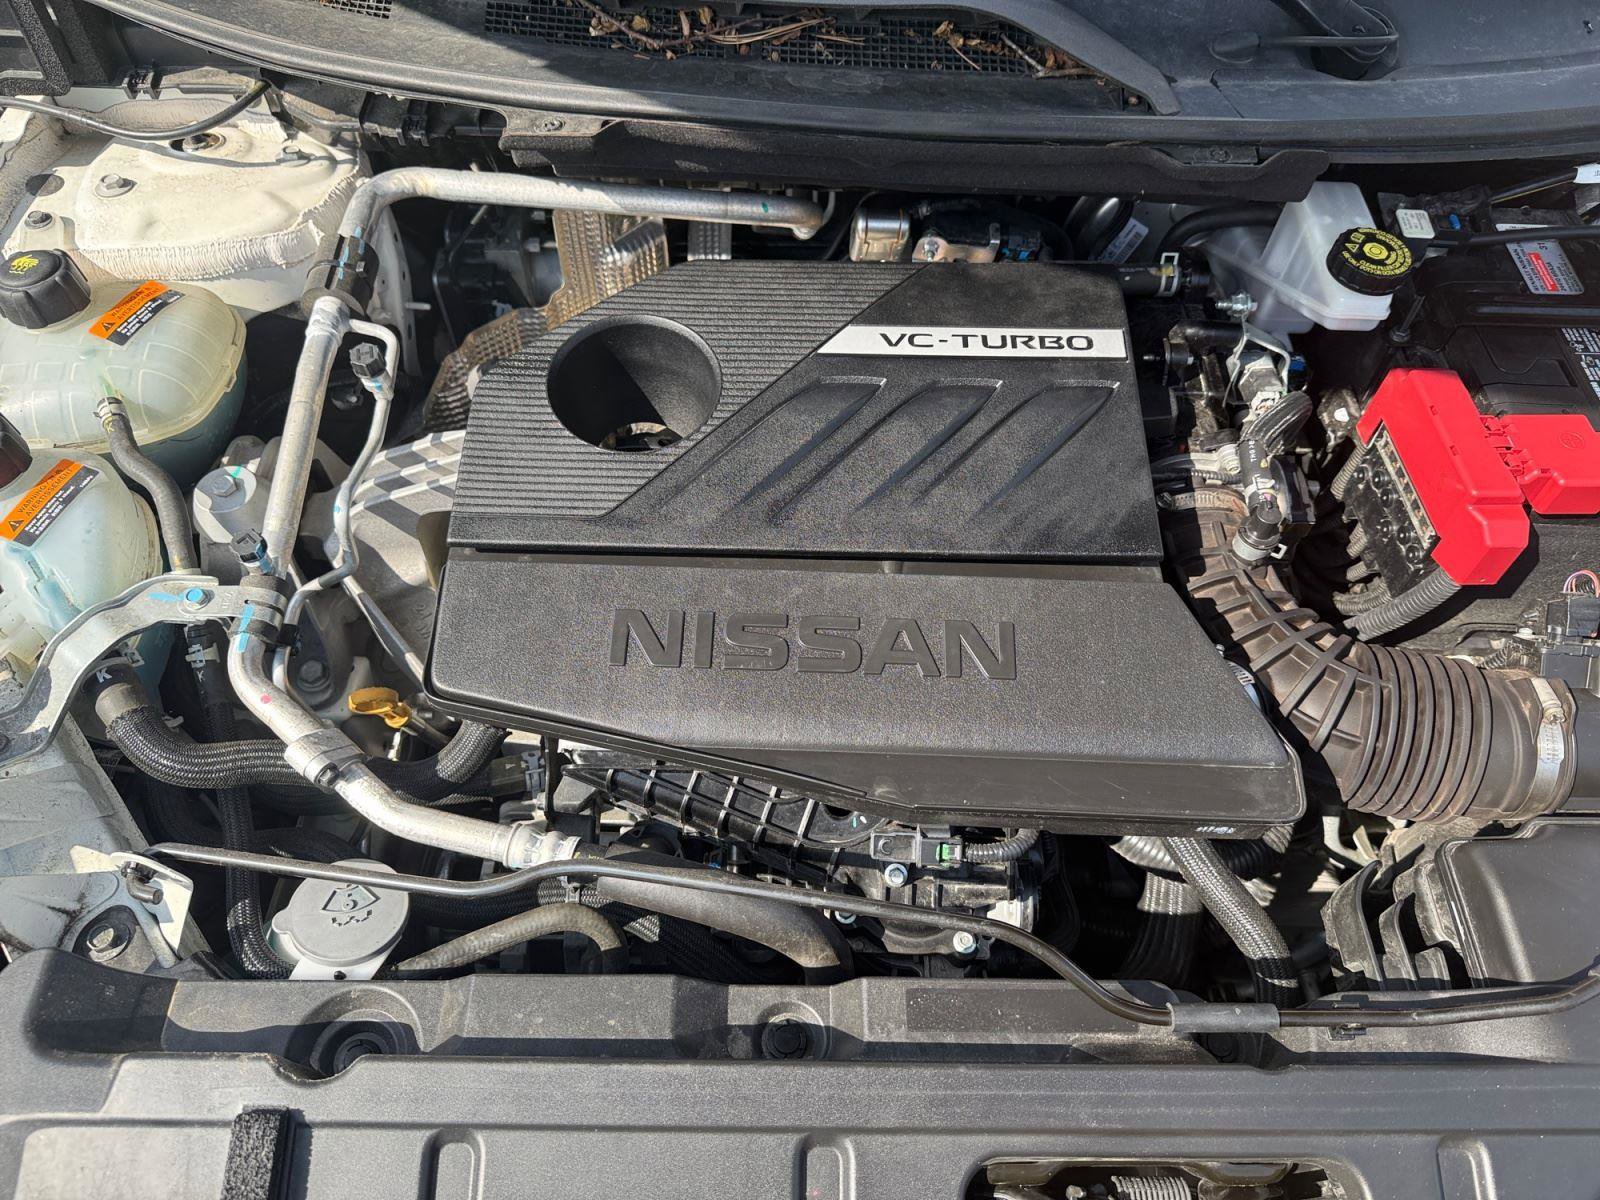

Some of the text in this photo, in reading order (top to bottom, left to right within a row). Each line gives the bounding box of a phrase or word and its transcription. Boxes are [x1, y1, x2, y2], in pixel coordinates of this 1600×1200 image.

[879, 332, 1094, 351] VC-TURBO
[18, 484, 47, 514] WARNING
[26, 467, 73, 517] AVERTISSEMENT
[608, 608, 1018, 680] NISSAN
